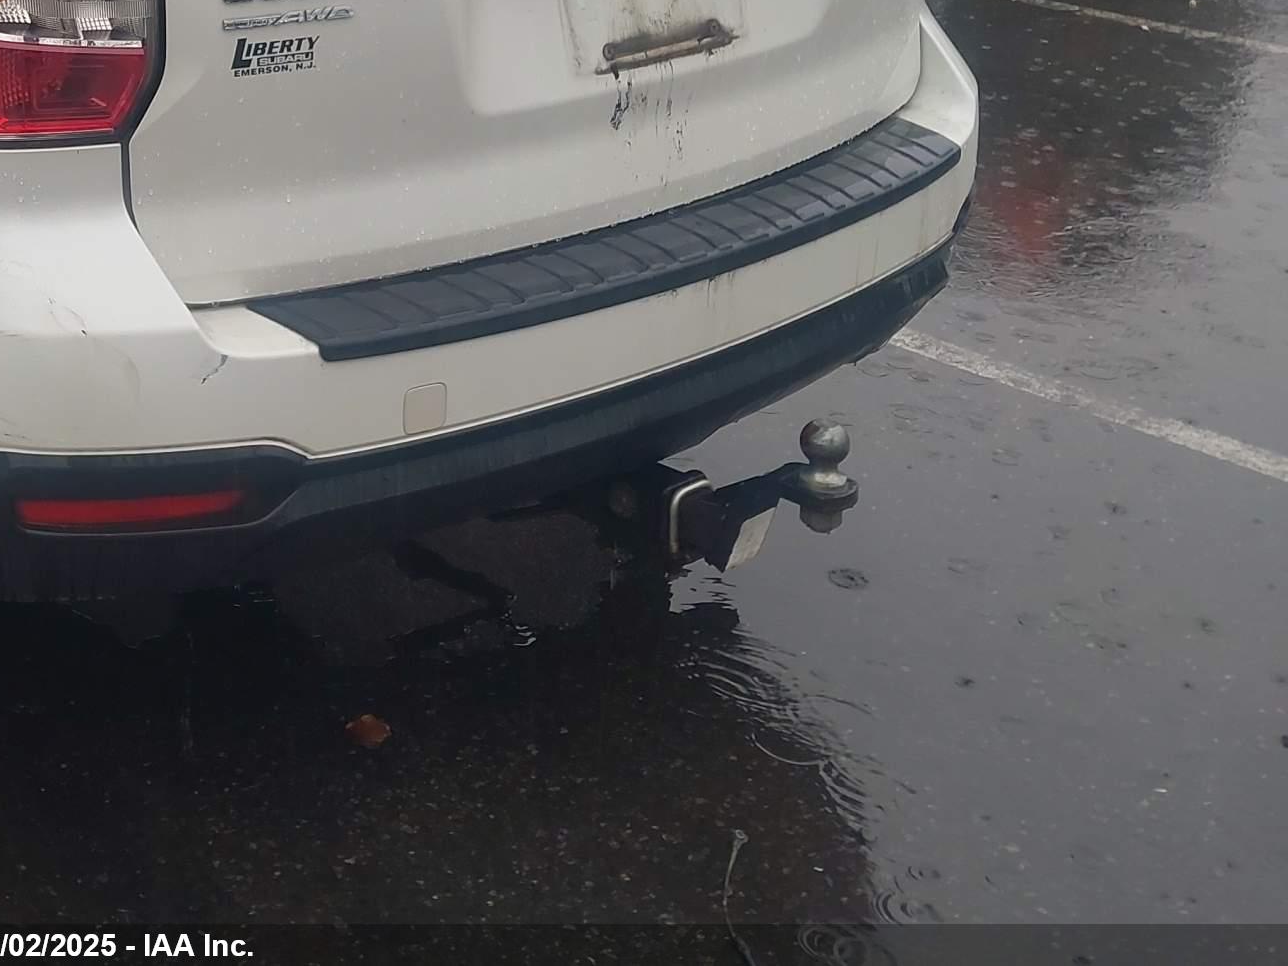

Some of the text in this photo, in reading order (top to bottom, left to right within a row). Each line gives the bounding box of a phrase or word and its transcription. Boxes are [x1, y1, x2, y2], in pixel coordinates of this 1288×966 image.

[231, 35, 320, 70] LIBERTY
[257, 52, 314, 67] SUBARU
[233, 62, 317, 78] EMERSON, N.J.
